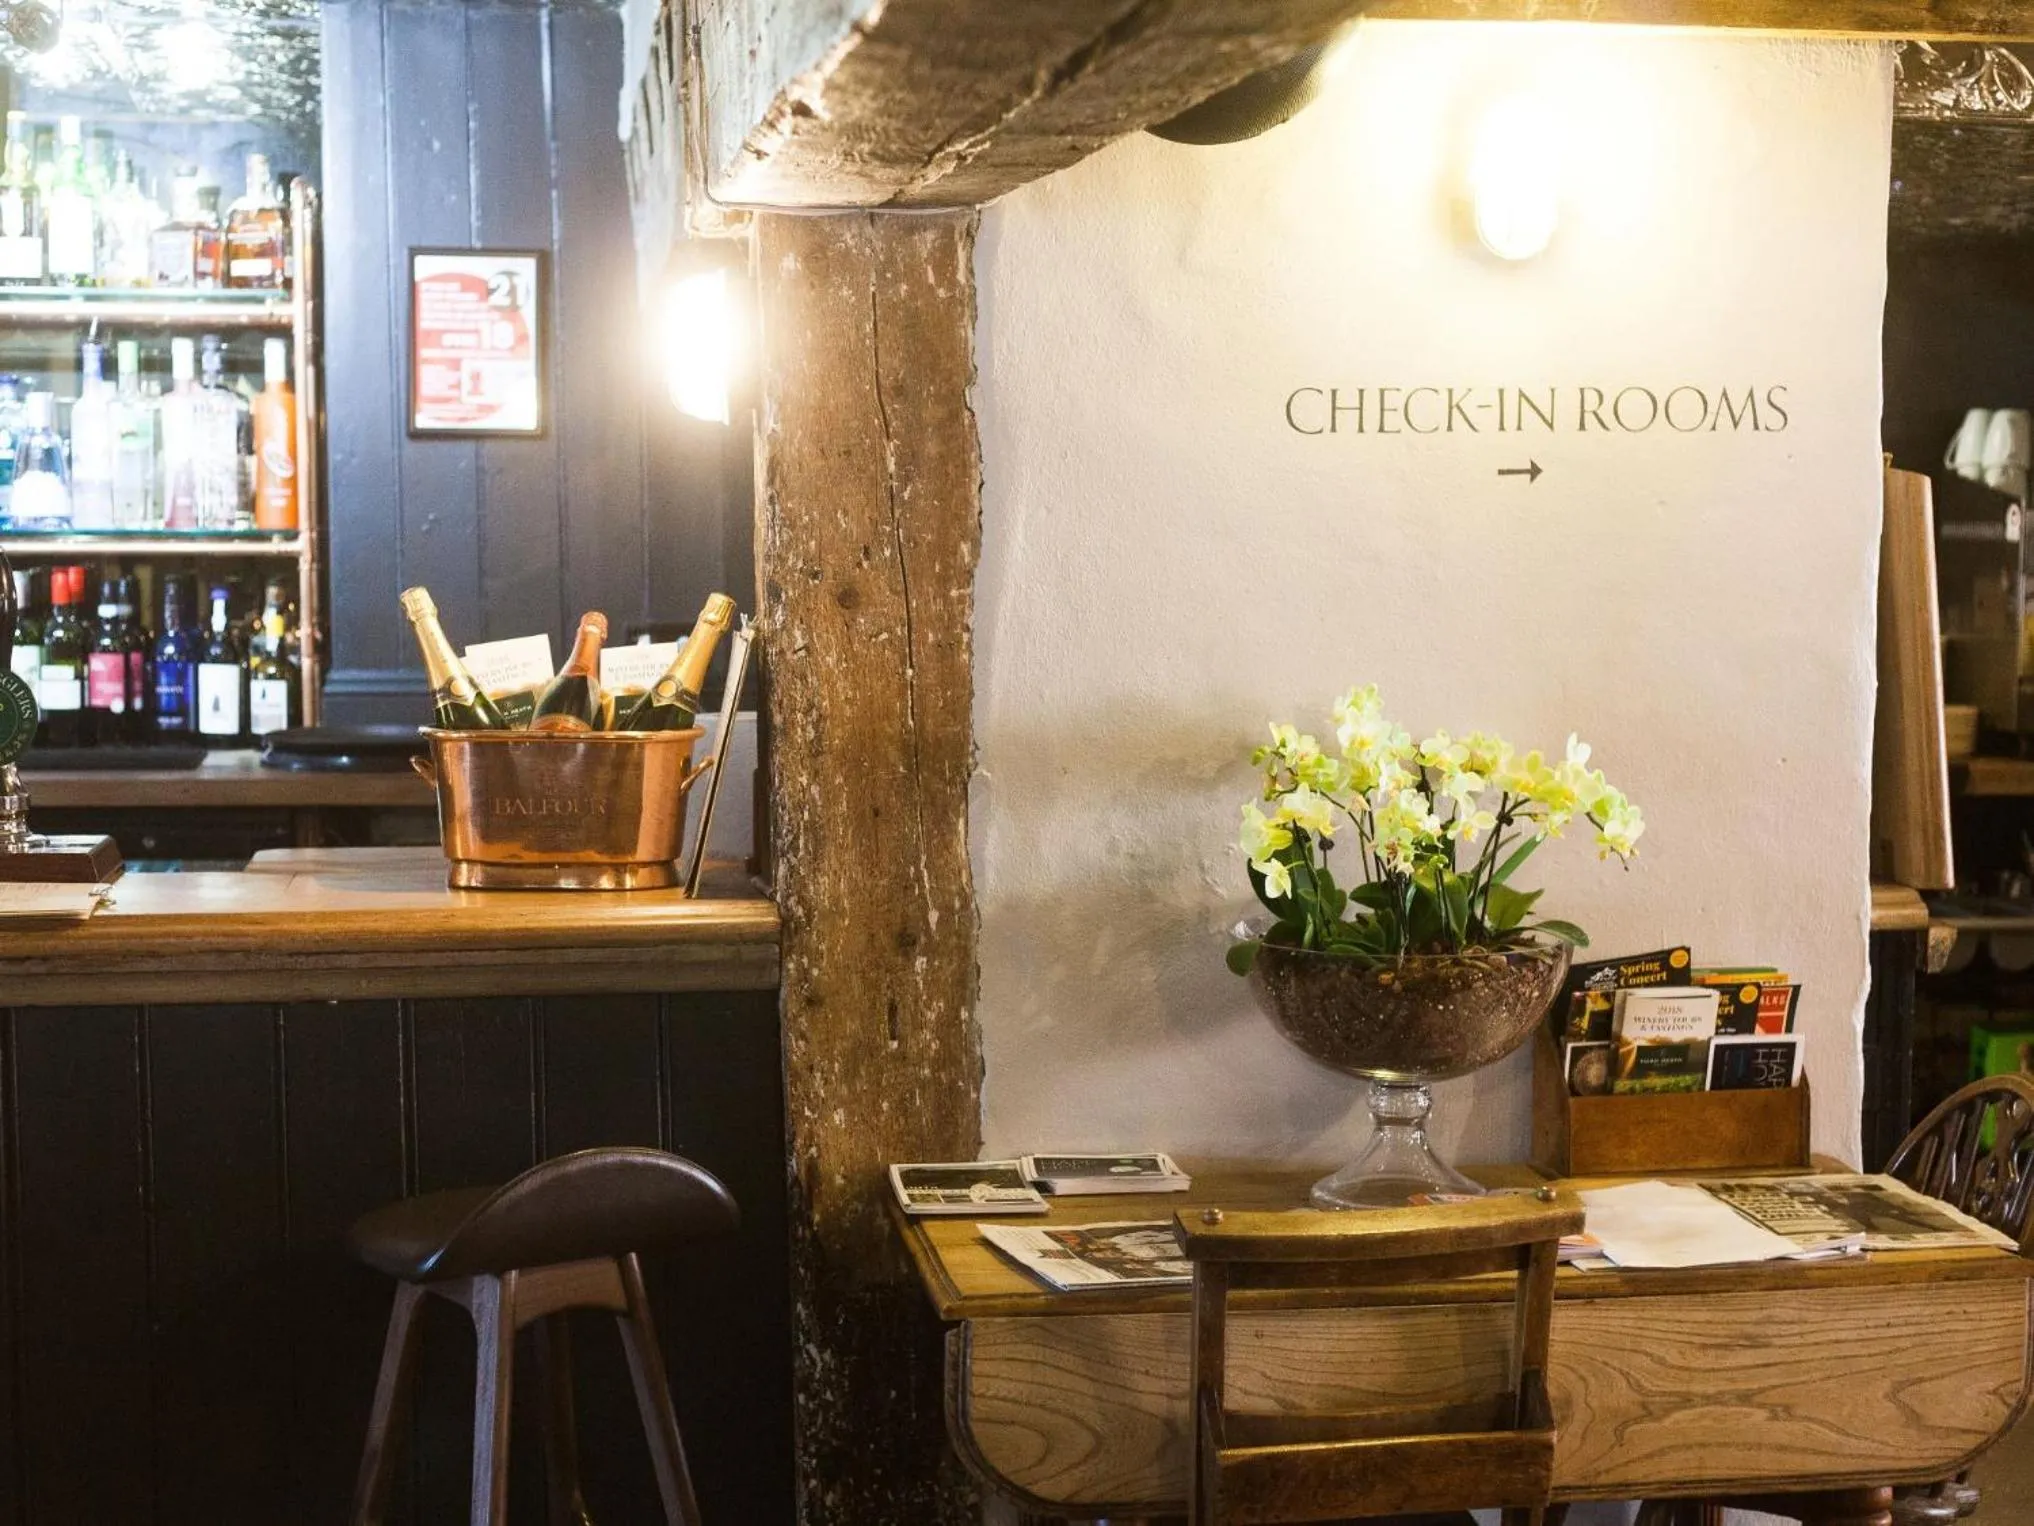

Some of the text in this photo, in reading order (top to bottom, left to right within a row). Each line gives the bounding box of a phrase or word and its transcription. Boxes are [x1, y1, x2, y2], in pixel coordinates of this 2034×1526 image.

[488, 274, 527, 307] 21
[1285, 386, 1788, 435] CHECK-IN ROOMS
[495, 798, 606, 815] BALFOUR
[1620, 961, 1661, 975] Spring
[1620, 971, 1667, 986] Concert
